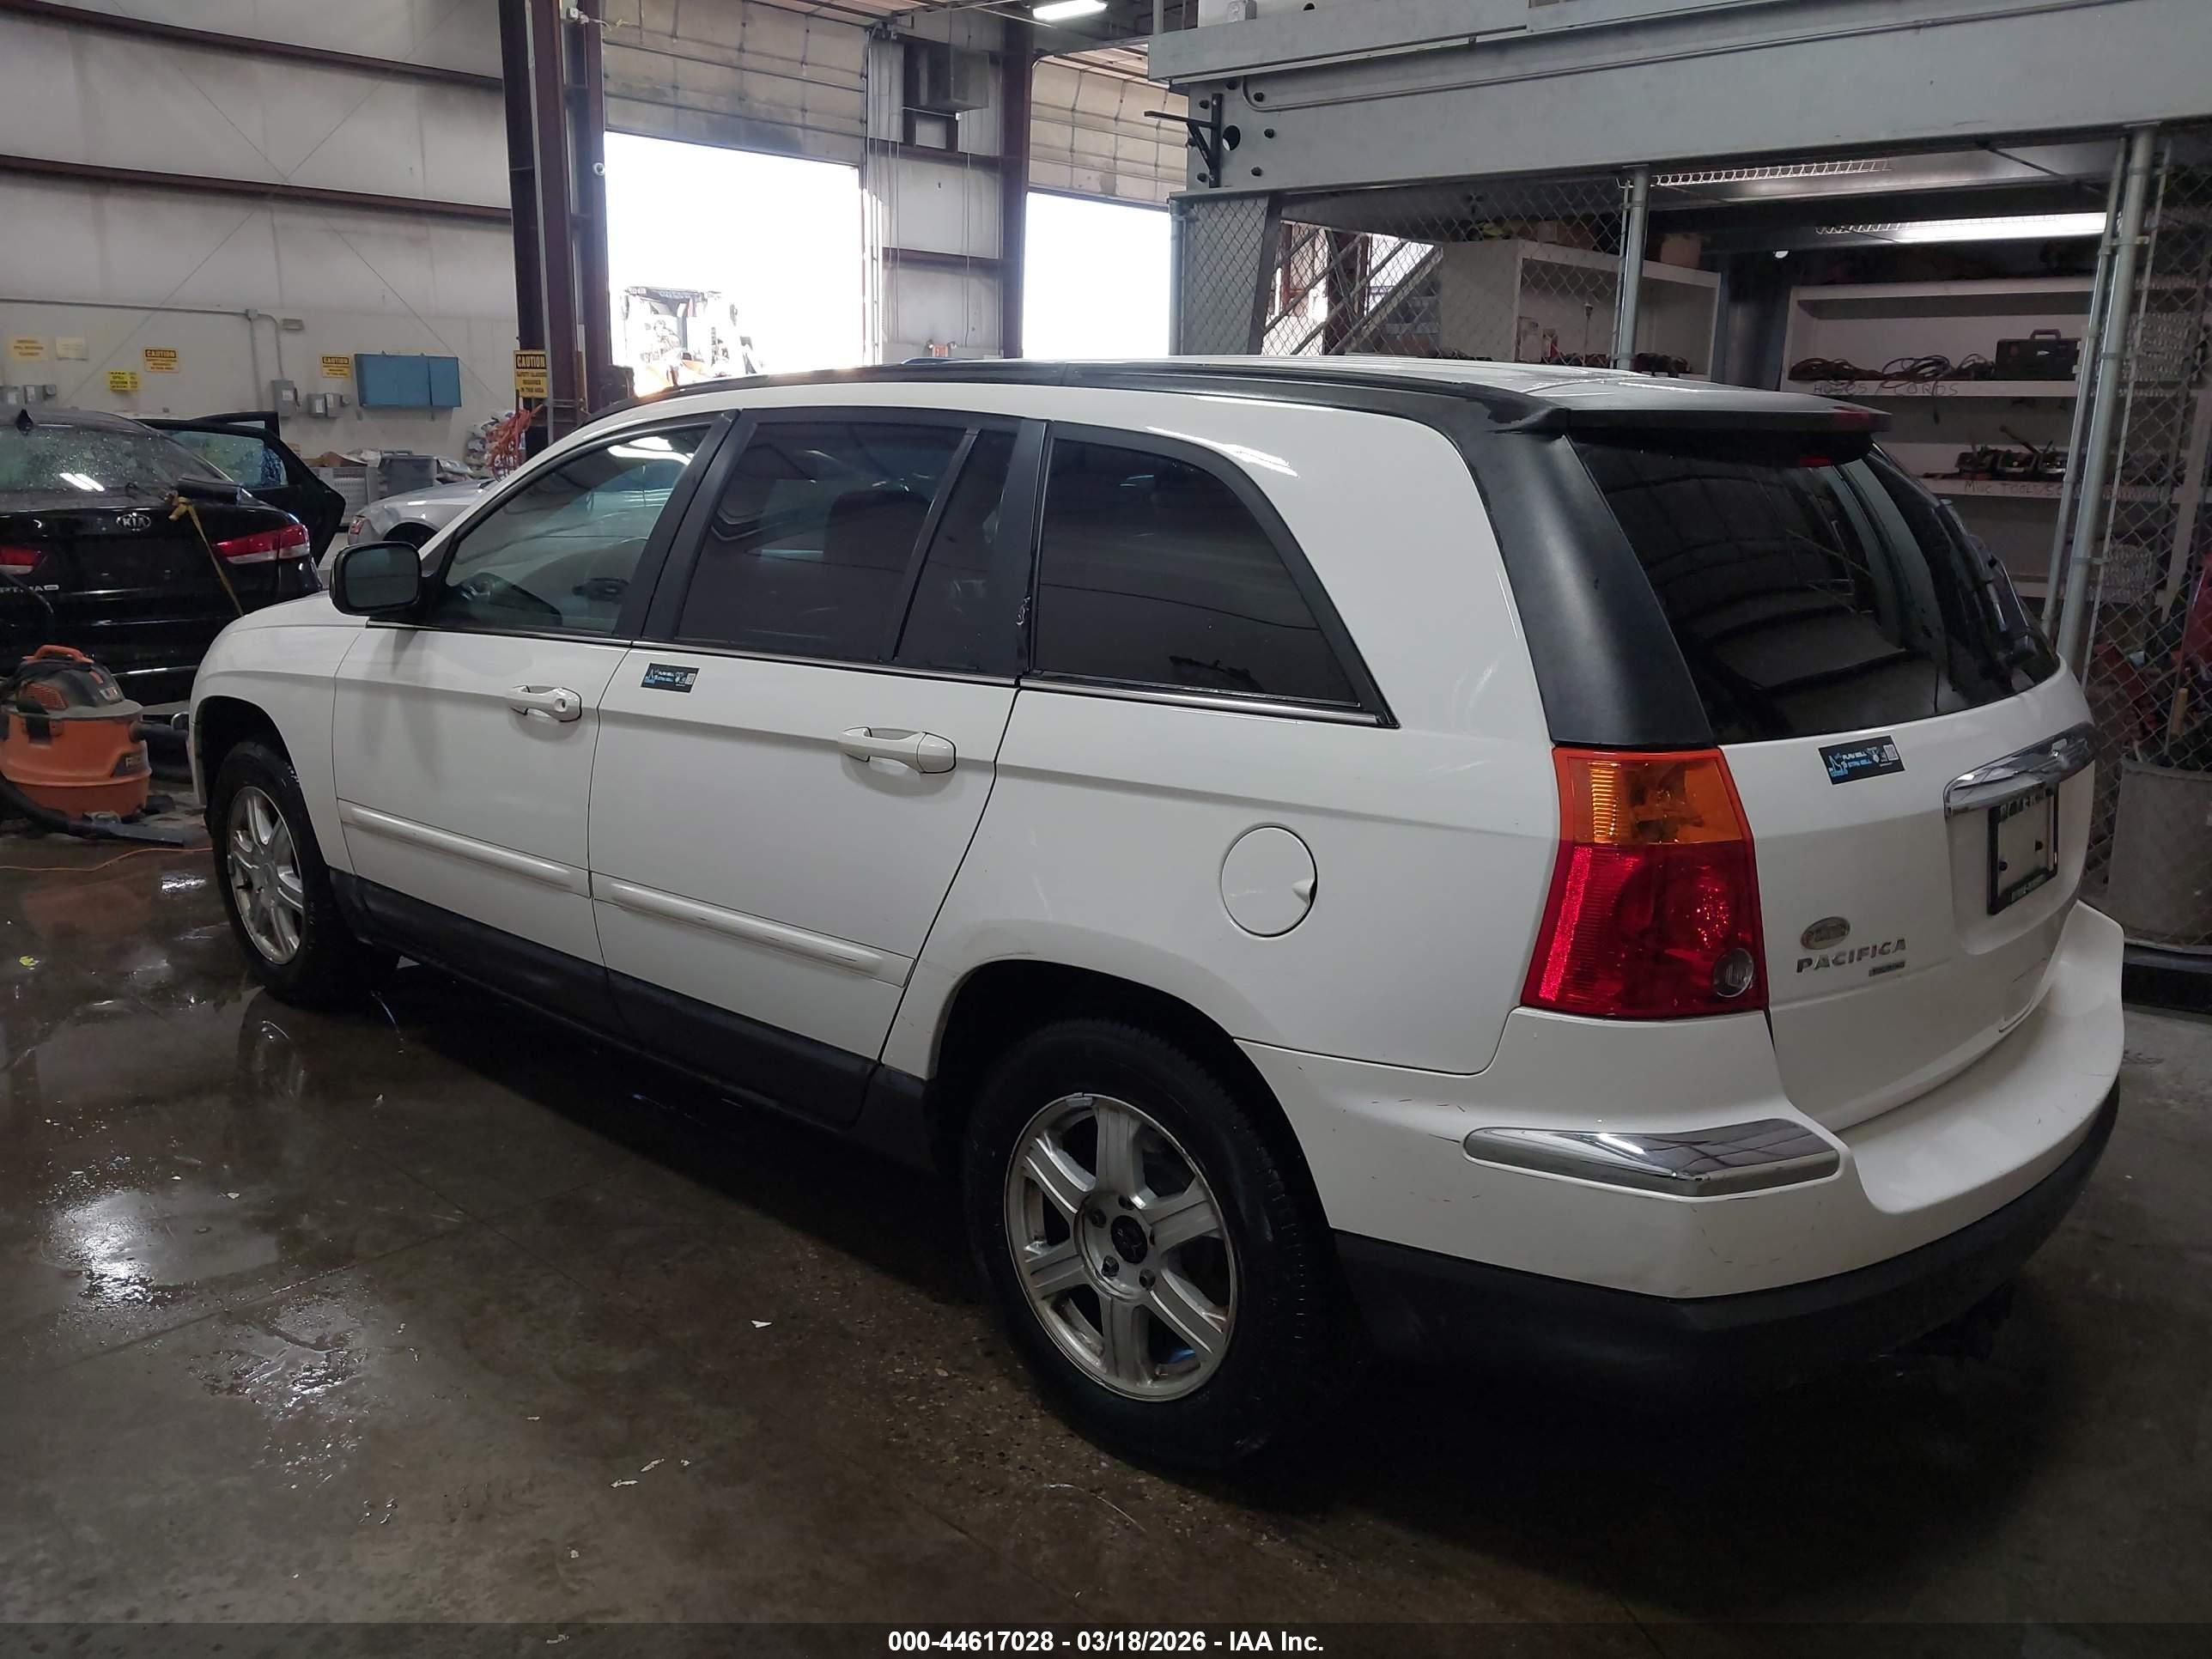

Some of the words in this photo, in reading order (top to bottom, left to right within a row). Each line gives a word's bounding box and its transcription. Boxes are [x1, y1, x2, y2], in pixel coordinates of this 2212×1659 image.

[146, 349, 175, 358] CAUTION
[517, 356, 545, 368] CAUTION
[121, 516, 148, 527] KIA
[1796, 938, 1907, 973] PACIFICA
